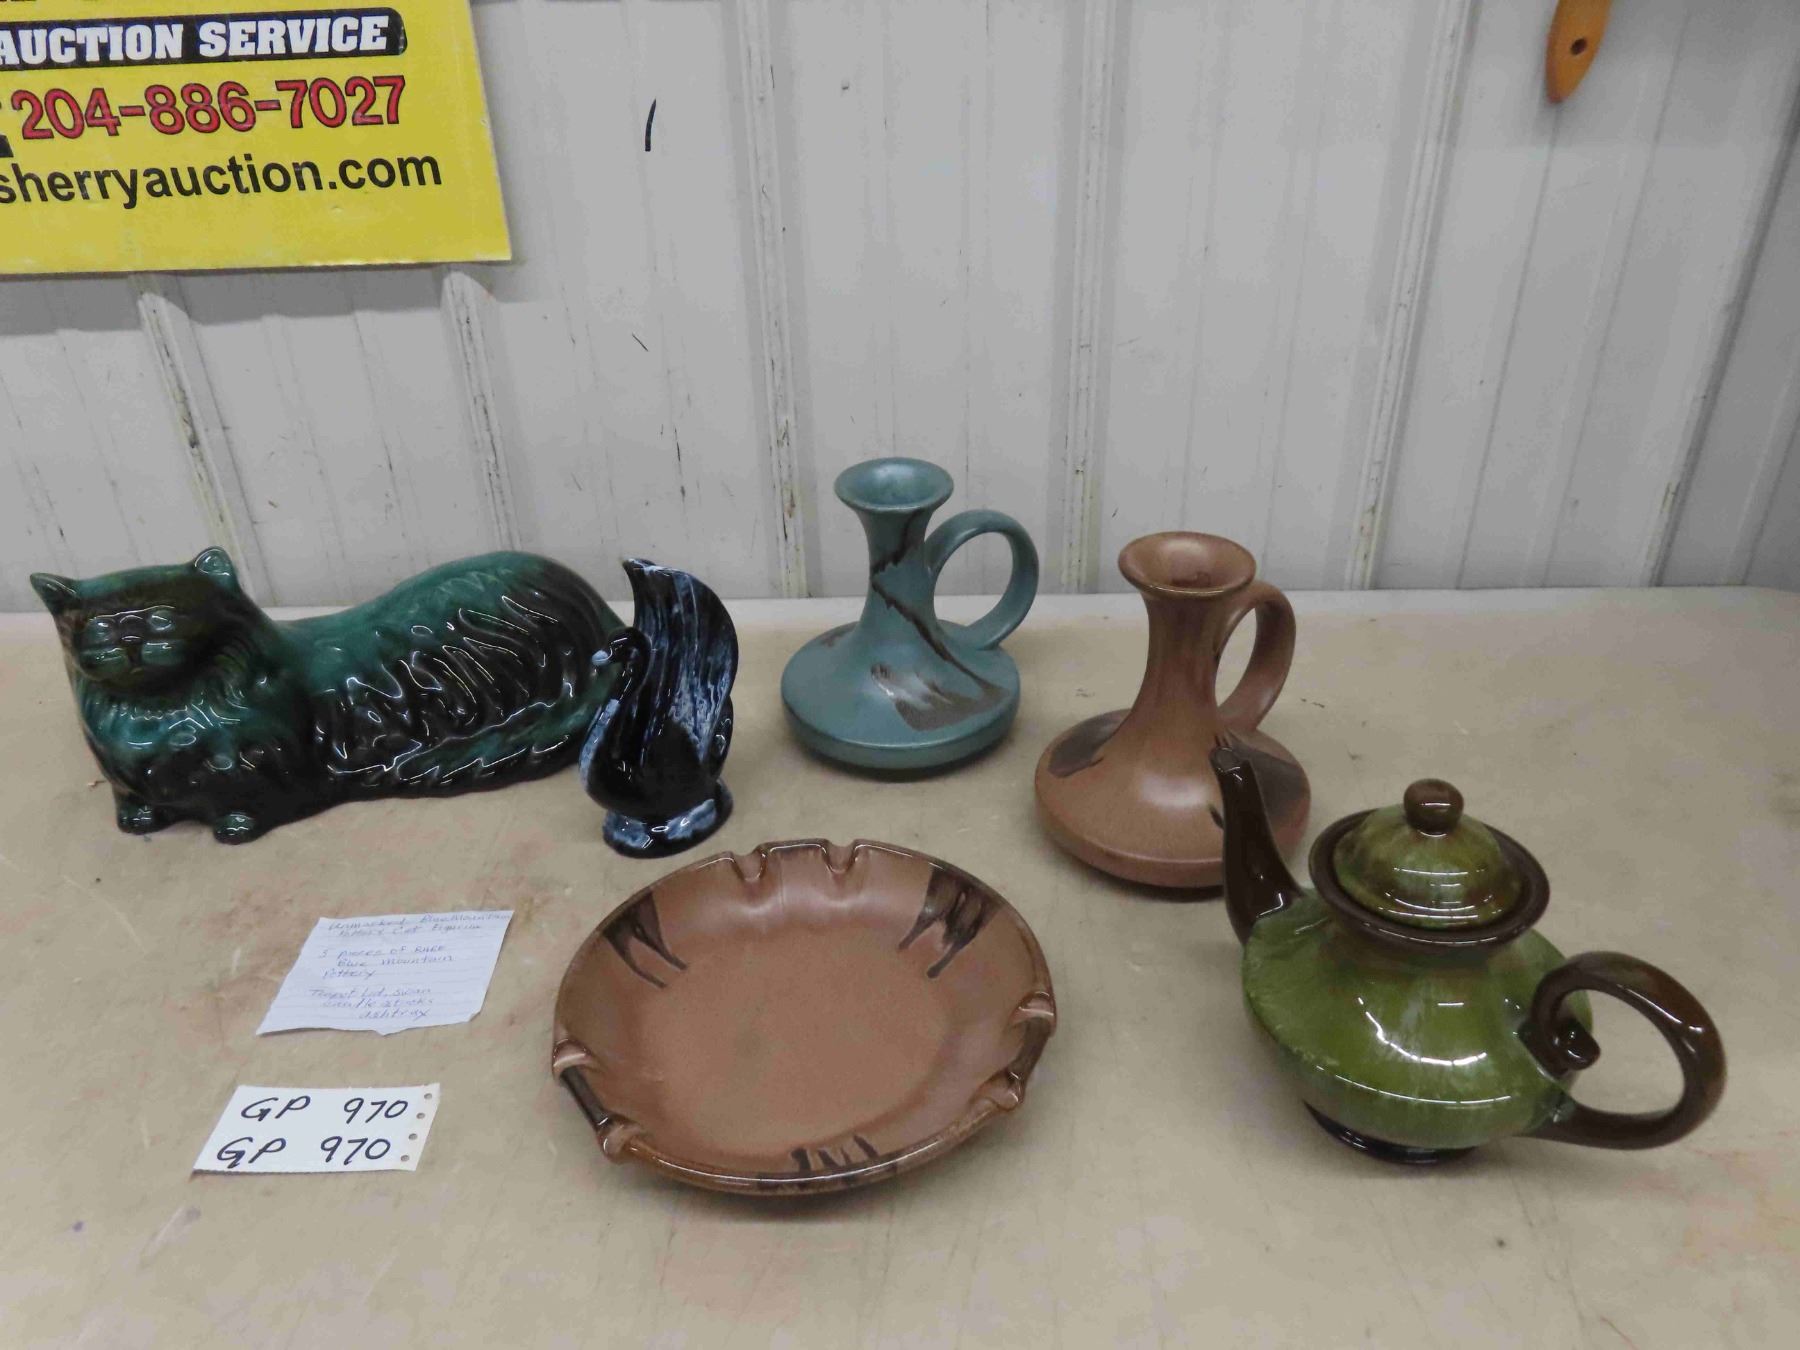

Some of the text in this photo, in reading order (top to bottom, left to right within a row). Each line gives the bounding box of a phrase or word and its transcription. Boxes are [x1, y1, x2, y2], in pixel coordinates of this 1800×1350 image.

[0, 16, 390, 65] AUCTION SERVICE
[11, 75, 406, 139] 204-886-7027
[0, 154, 442, 209] sherryauction.com
[241, 1095, 409, 1124] GP 970
[216, 1135, 391, 1169] GP 970
